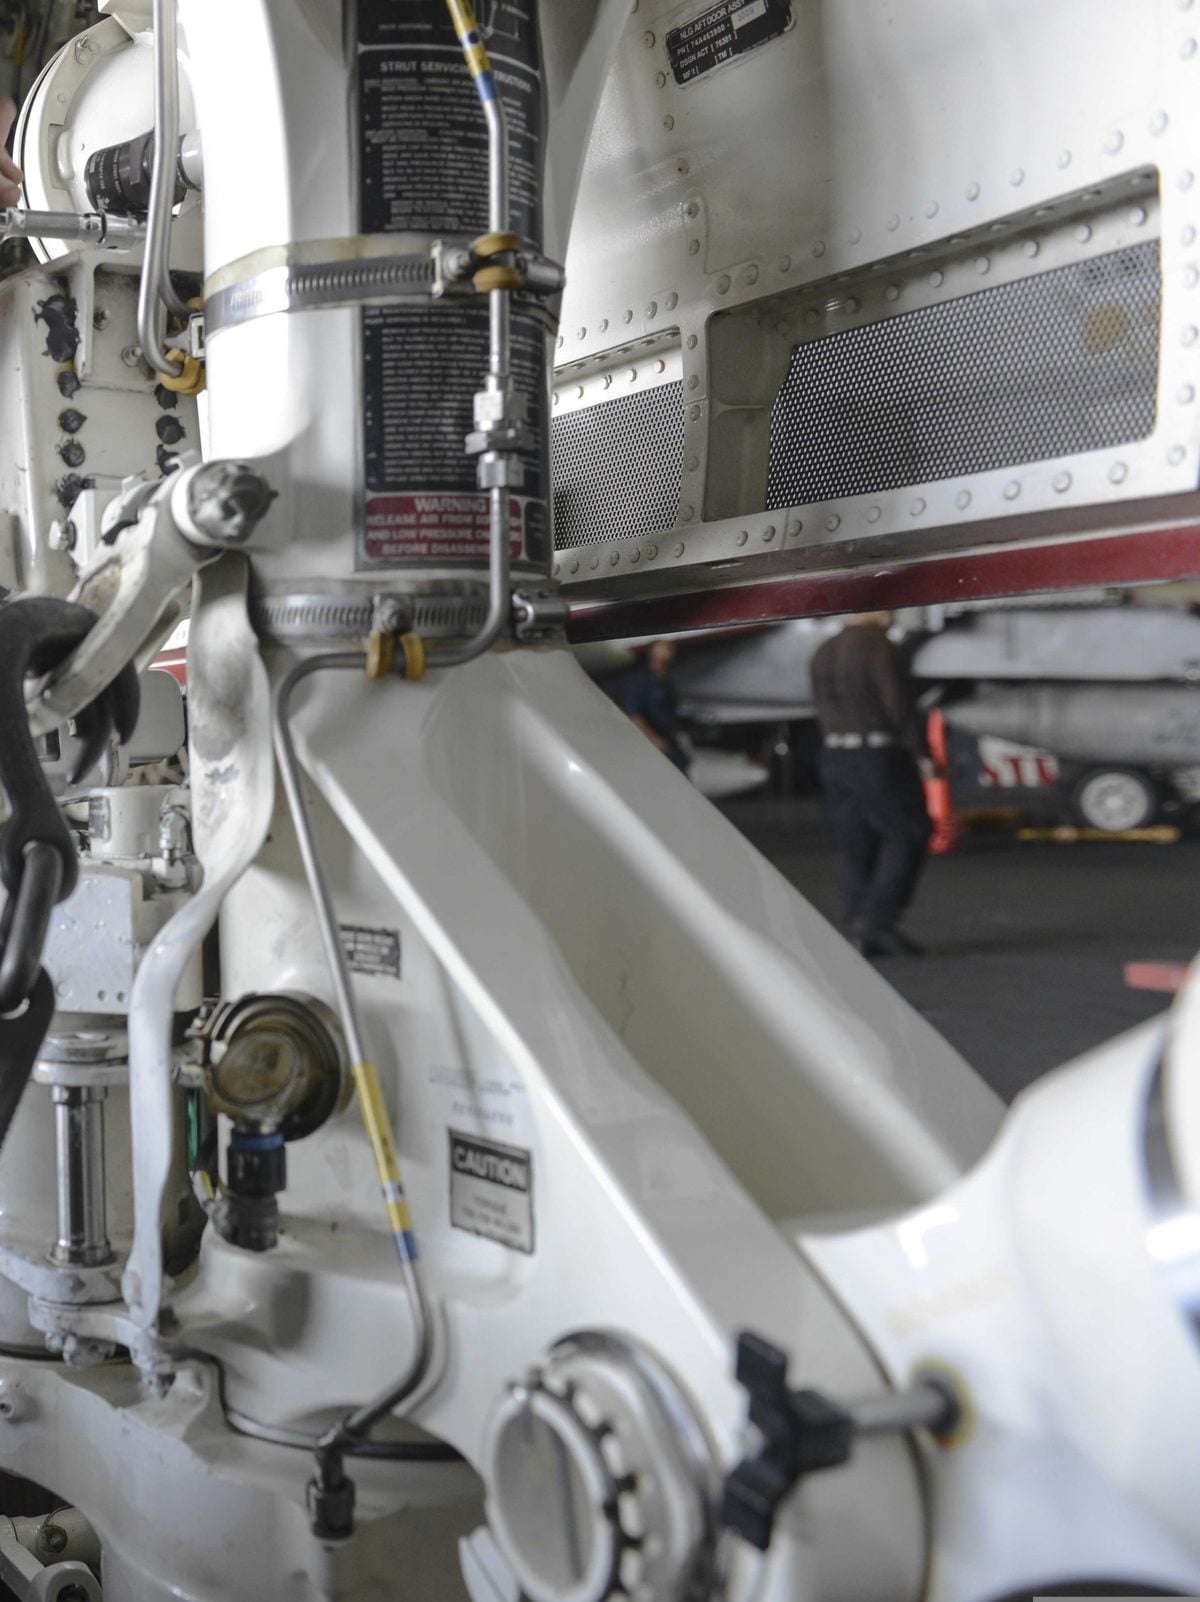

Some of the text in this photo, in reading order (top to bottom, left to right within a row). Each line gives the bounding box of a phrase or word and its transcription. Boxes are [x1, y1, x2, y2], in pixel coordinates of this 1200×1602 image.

[680, 29, 693, 40] NLG
[694, 20, 707, 33] AFT
[707, 8, 727, 25] DOOR
[680, 54, 696, 68] DSGN
[697, 47, 709, 61] ACT
[380, 61, 417, 72] STRUT
[414, 498, 486, 512] WARNING
[366, 514, 417, 525] RELEASE
[419, 513, 440, 524] AIR
[441, 514, 473, 524] FROM
[367, 529, 390, 541] AND
[392, 529, 417, 540] LOW
[419, 529, 473, 540] PRESSURE
[381, 543, 428, 554] BEFORE
[454, 1145, 528, 1188] CAUTION
